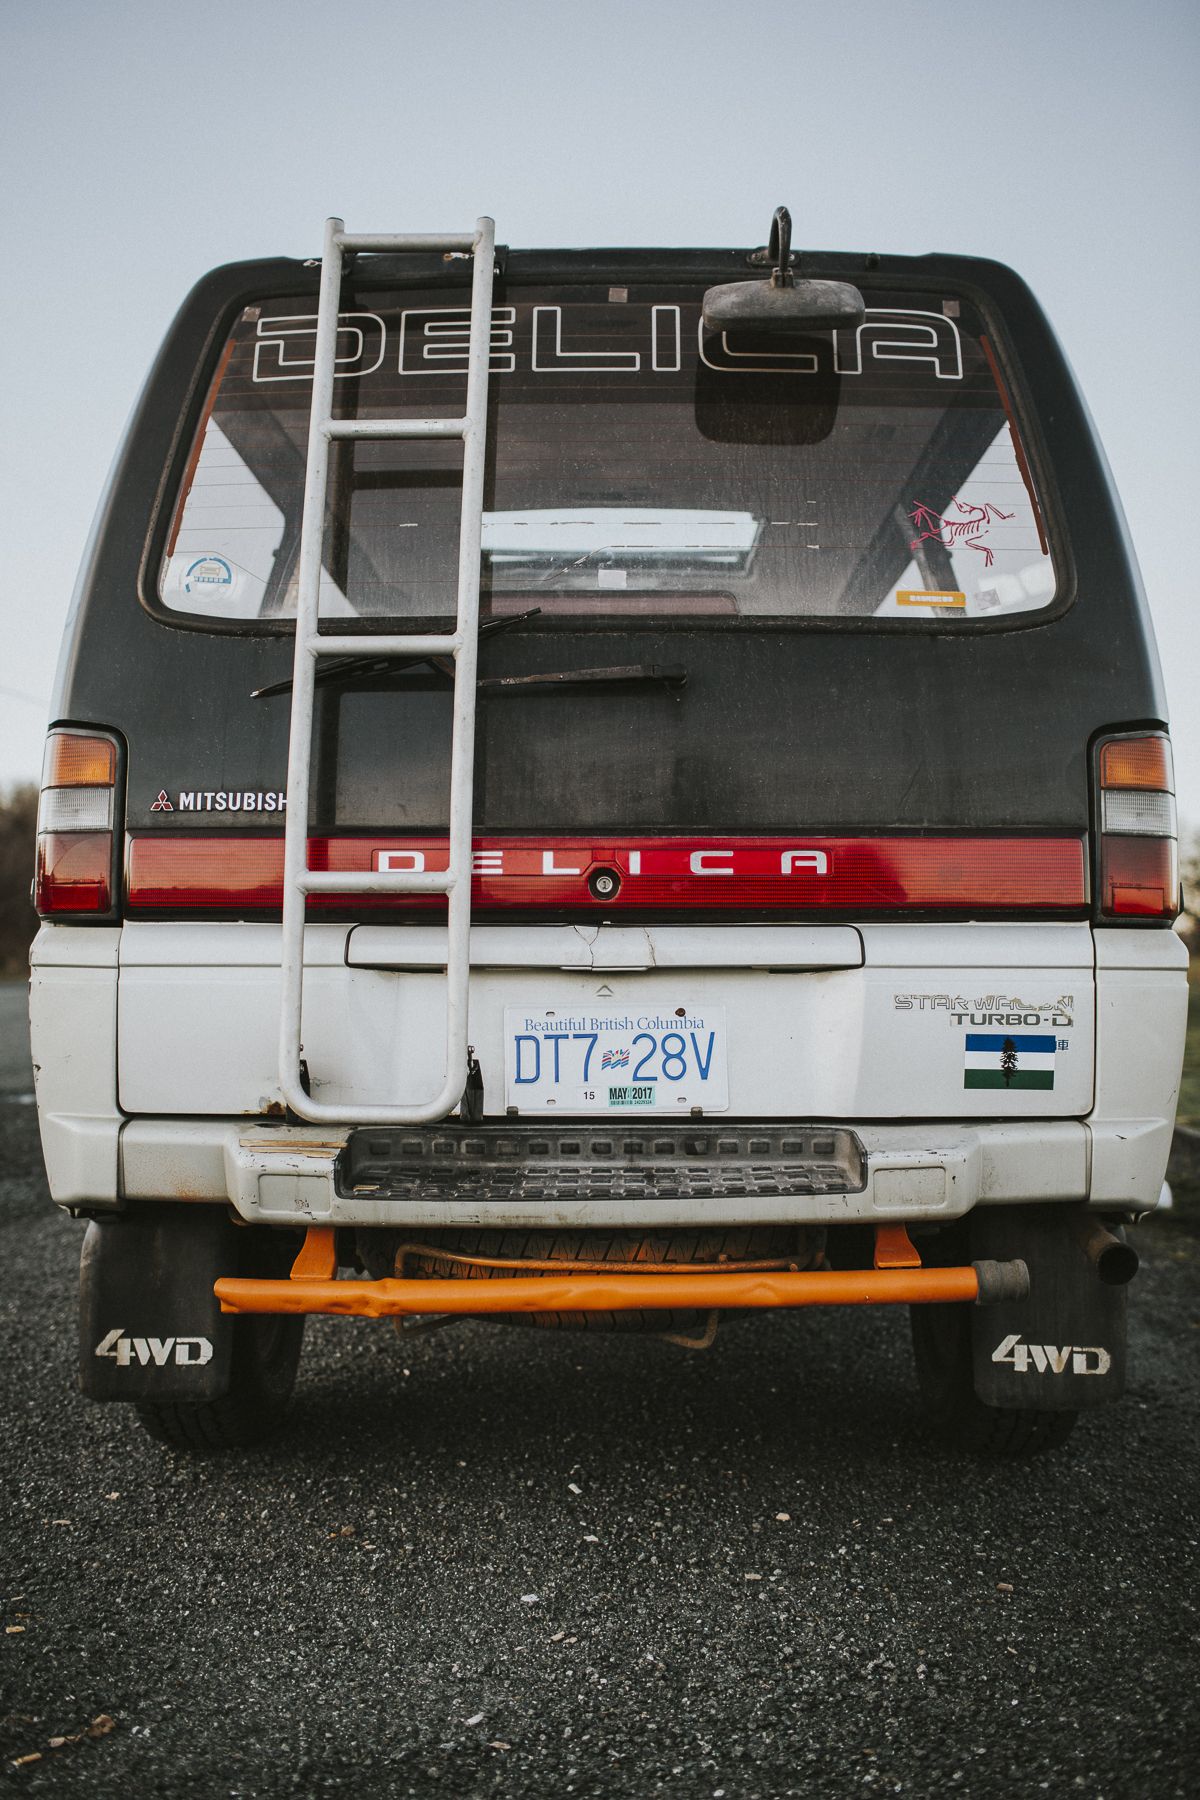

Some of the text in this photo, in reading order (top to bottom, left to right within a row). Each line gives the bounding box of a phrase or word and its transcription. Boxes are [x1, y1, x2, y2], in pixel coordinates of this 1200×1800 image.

[253, 305, 963, 382] DELICA
[179, 792, 287, 811] MITSUBISH
[378, 851, 829, 875] DELICA
[895, 995, 968, 1010] STAR
[525, 1016, 705, 1032] Beautiful British Columbia
[514, 1031, 716, 1084] DT7 28V
[583, 1087, 653, 1100] 15 MAY 2017
[95, 1329, 213, 1366] 4WD
[992, 1335, 1110, 1375] 4WD
